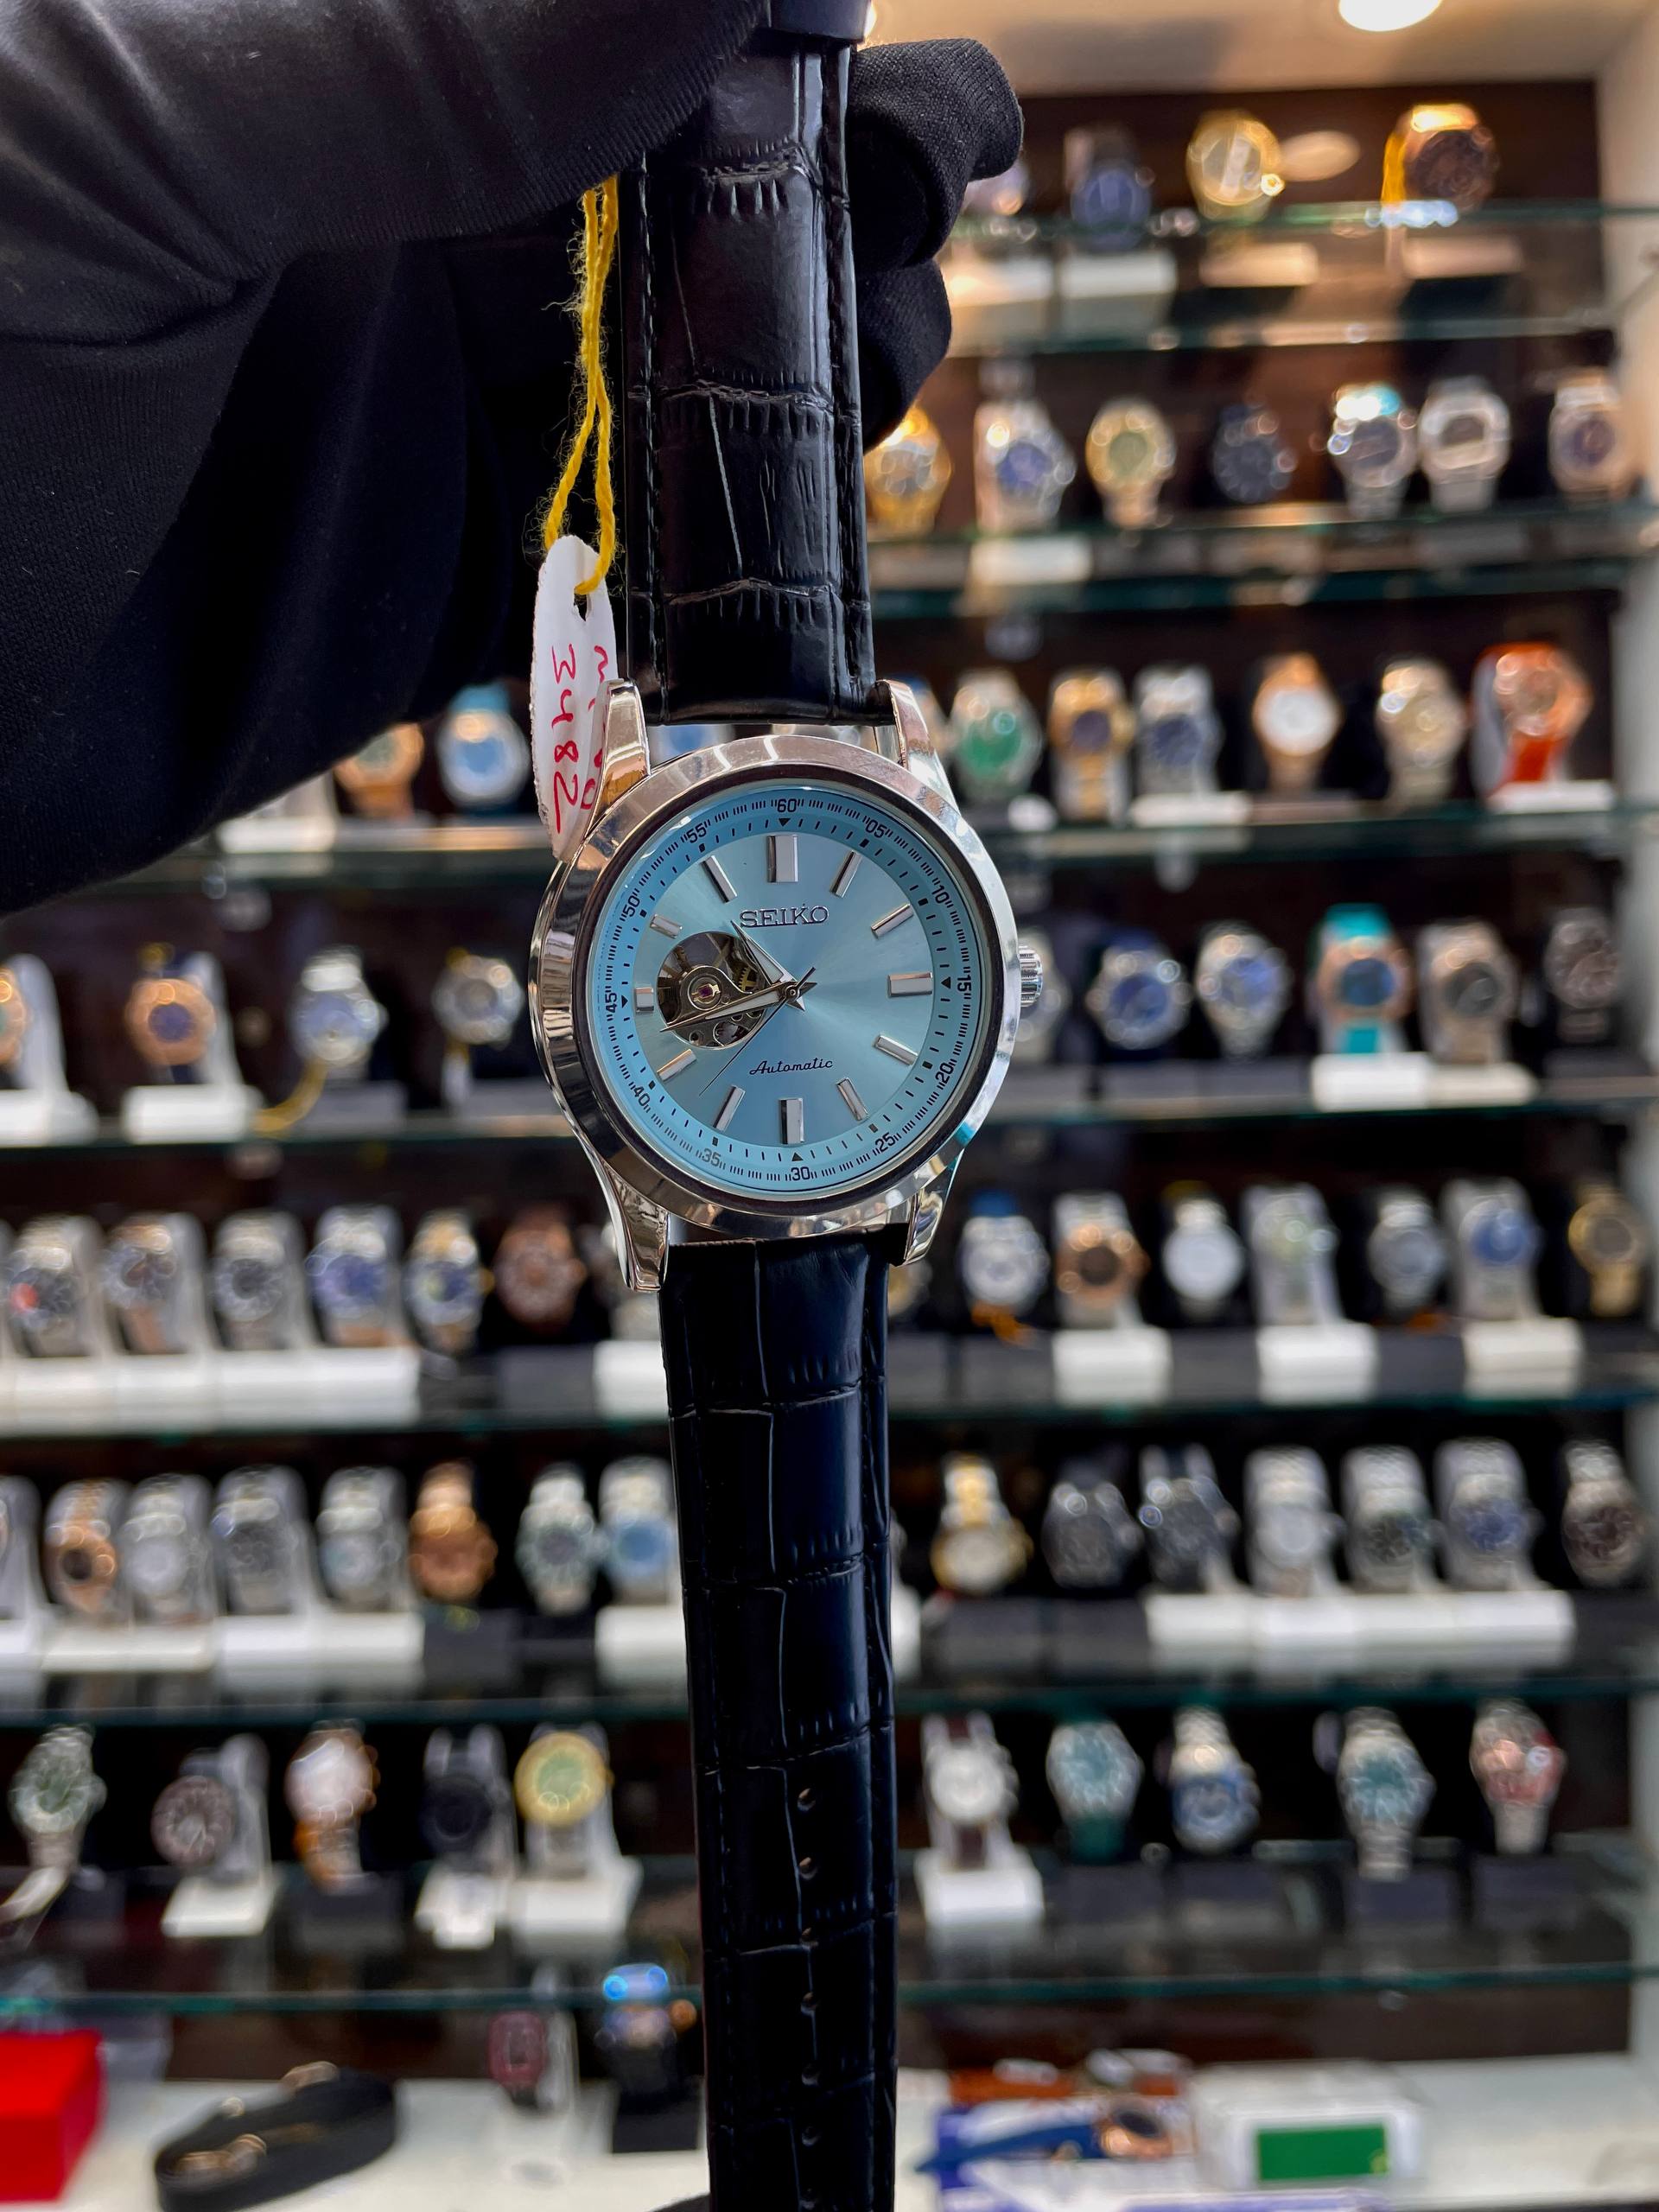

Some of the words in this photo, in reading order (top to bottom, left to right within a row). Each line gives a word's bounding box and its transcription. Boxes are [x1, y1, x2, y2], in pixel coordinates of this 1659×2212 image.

[777, 798, 797, 813] 60
[687, 825, 708, 844] 55
[865, 820, 886, 838] 05
[931, 884, 950, 905] 10
[621, 895, 641, 918] 50
[740, 905, 830, 928] SEIKO
[957, 975, 972, 992] 15
[605, 993, 617, 1013] 45
[749, 1057, 833, 1075] Automatic
[935, 1061, 954, 1084] 20
[633, 1084, 651, 1108] 40
[874, 1132, 896, 1153] 25
[701, 1147, 721, 1166] 35
[791, 1166, 811, 1181] 30
